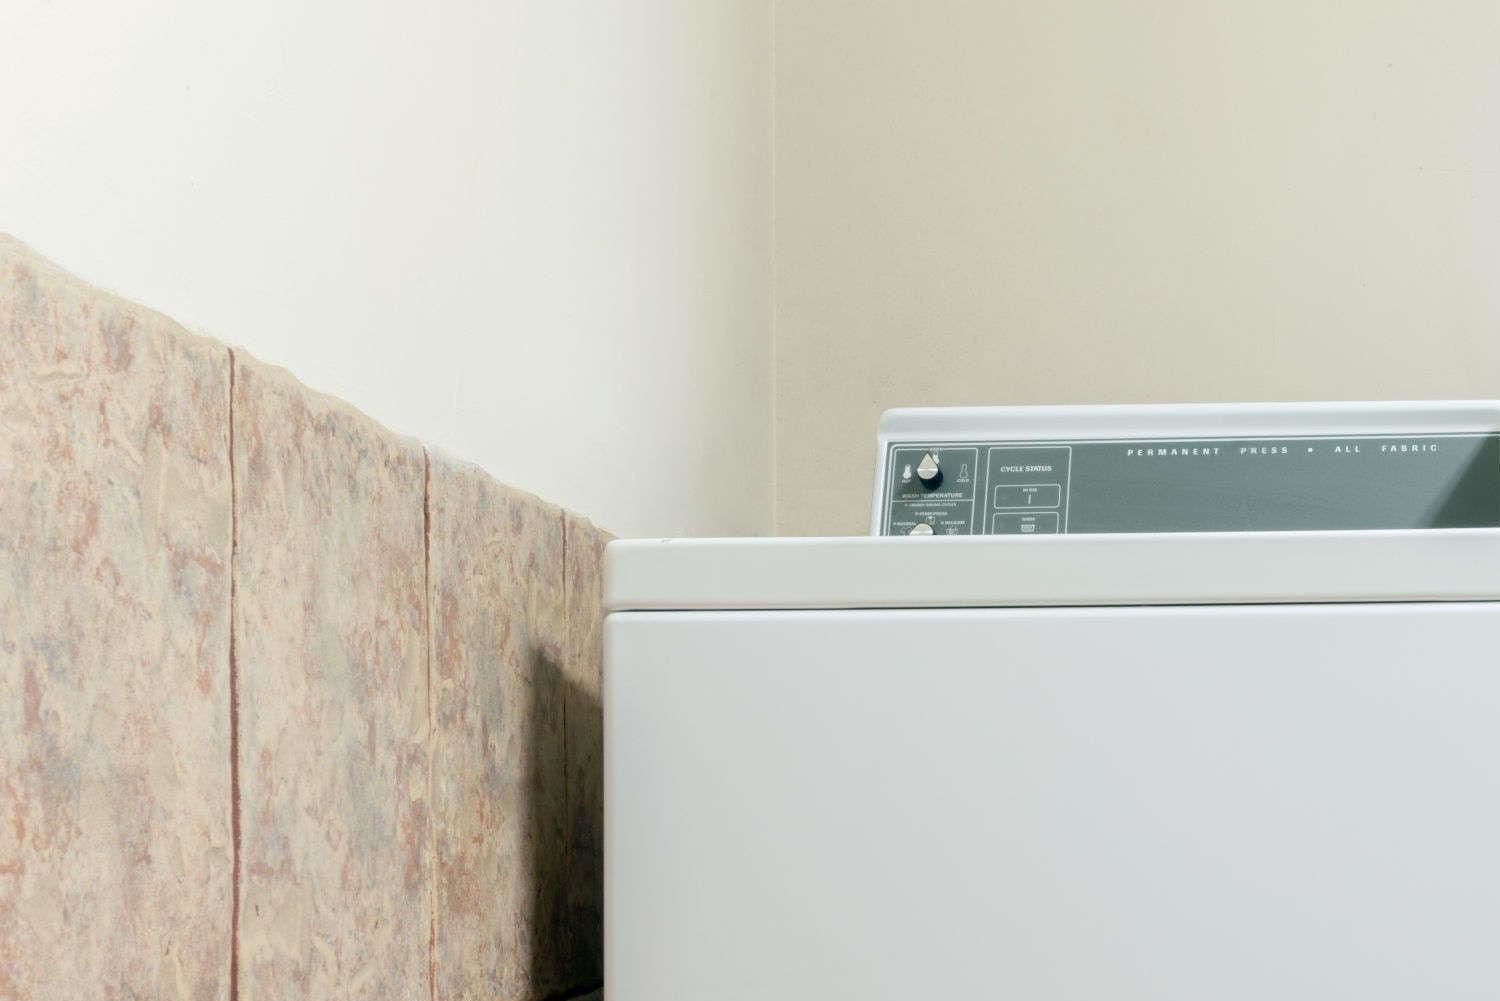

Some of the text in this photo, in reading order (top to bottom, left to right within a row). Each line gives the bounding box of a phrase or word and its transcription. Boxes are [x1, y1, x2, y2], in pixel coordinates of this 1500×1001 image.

[1127, 443, 1439, 457] PERMANENT PRESS ALL FABRIC
[1000, 465, 1023, 473] CYCLE
